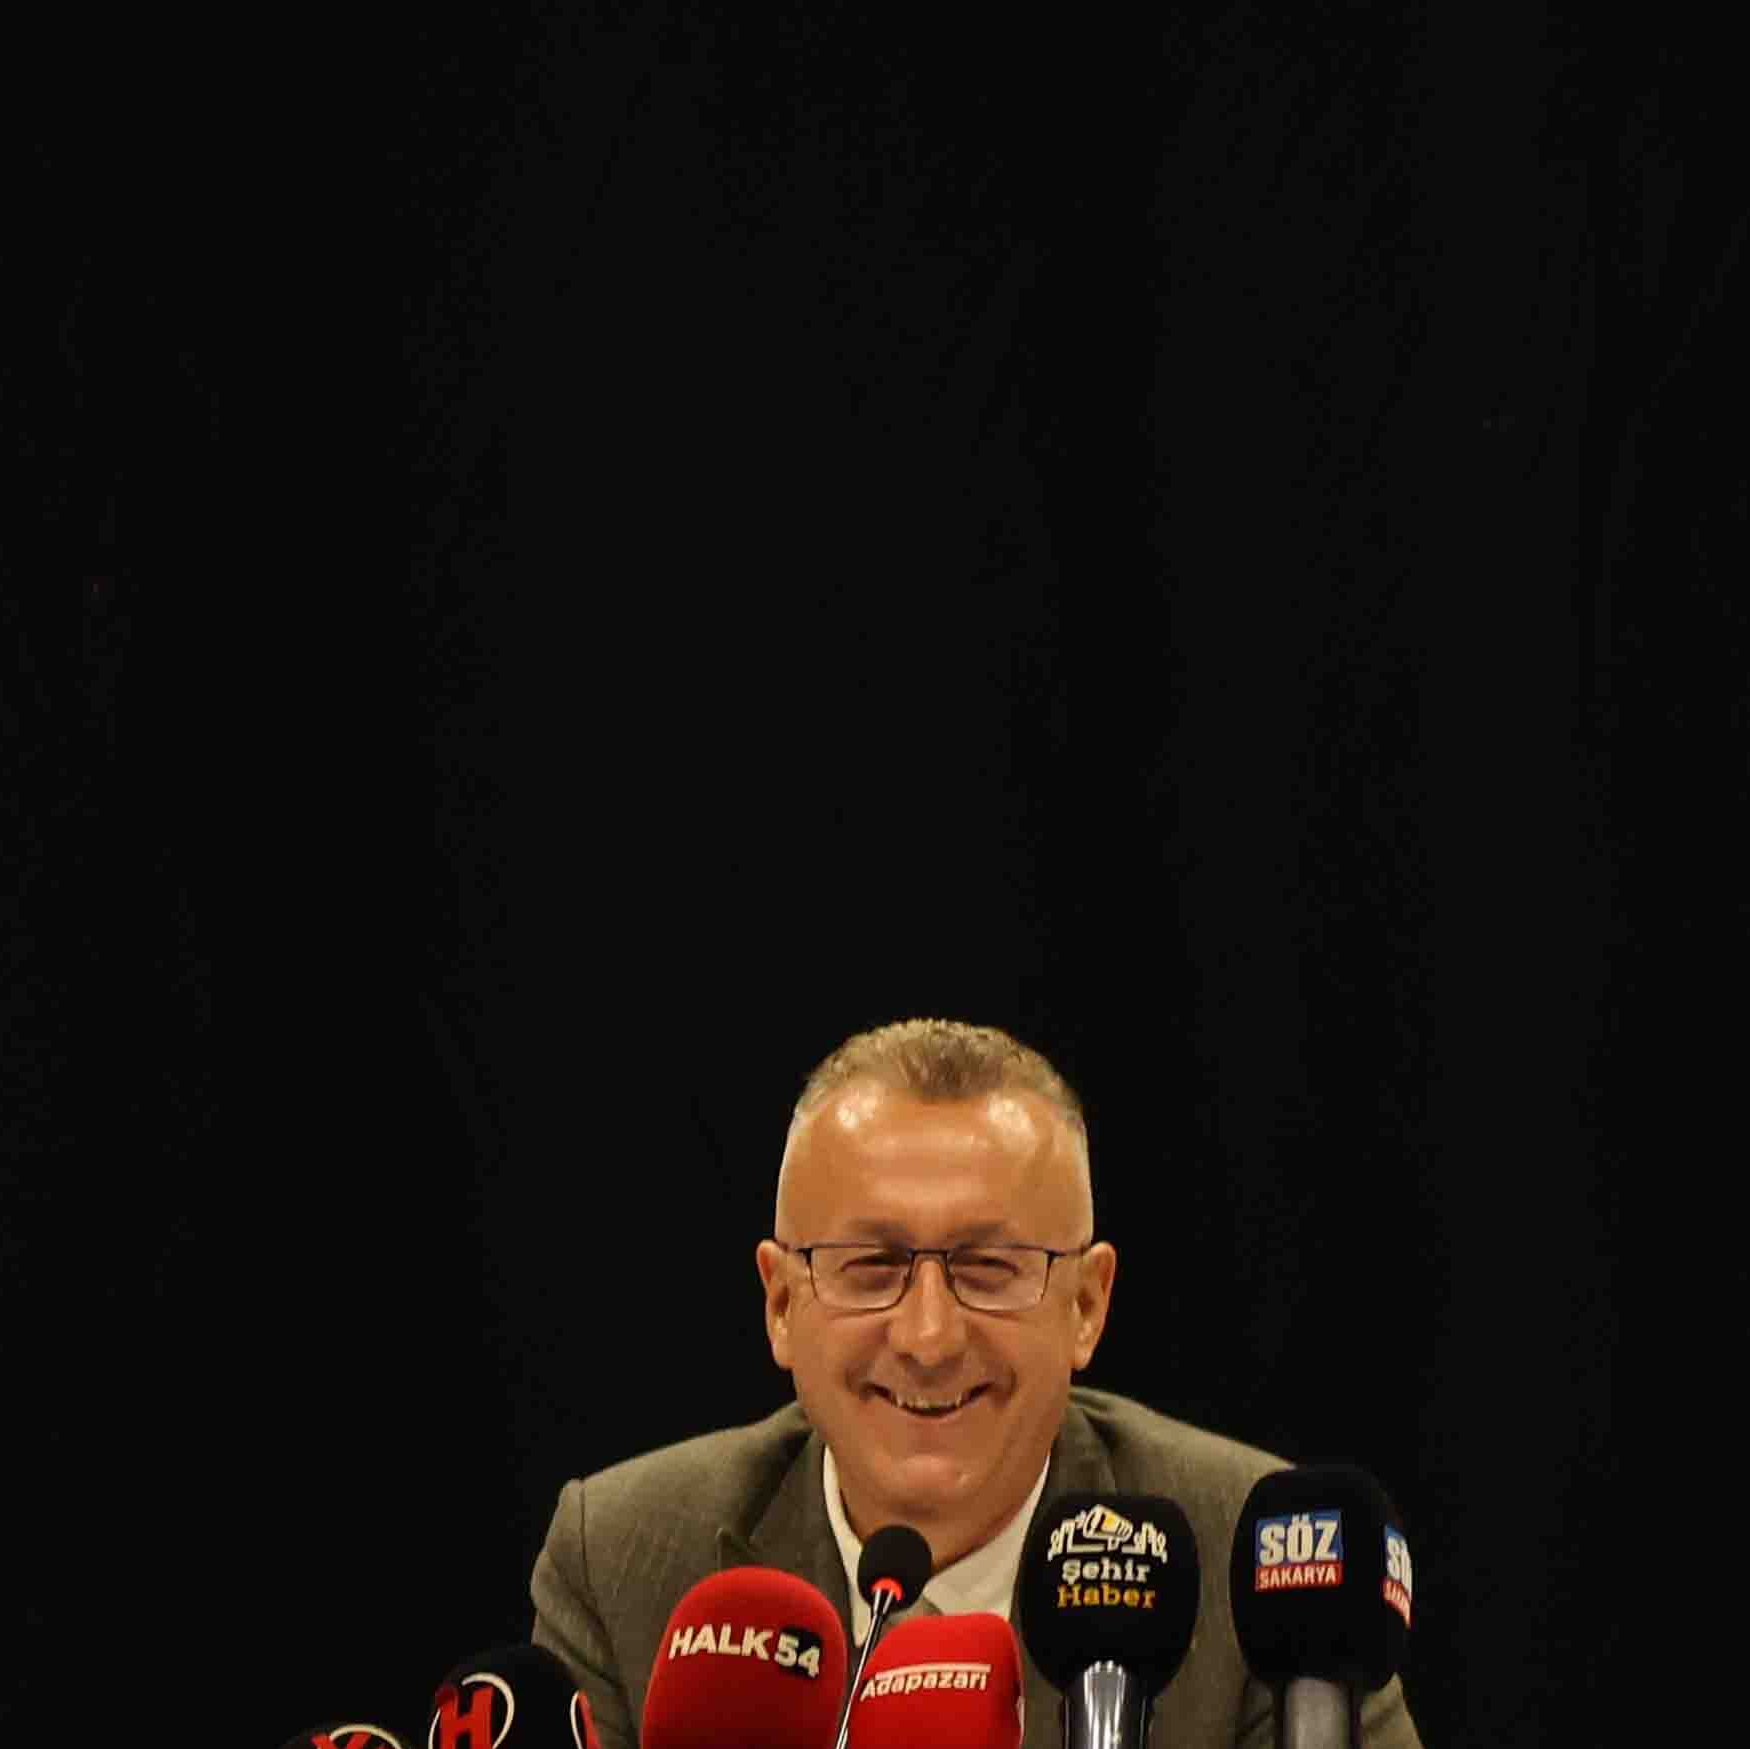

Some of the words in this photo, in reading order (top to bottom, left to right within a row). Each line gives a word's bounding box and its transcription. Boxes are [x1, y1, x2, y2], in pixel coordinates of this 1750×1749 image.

[1259, 1513, 1339, 1566] SÖZ
[1062, 1556, 1150, 1585] Şehir
[1259, 1565, 1336, 1591] SAKARYA
[1057, 1583, 1155, 1608] Haber
[668, 1622, 773, 1661] HALK
[774, 1632, 821, 1679] 54
